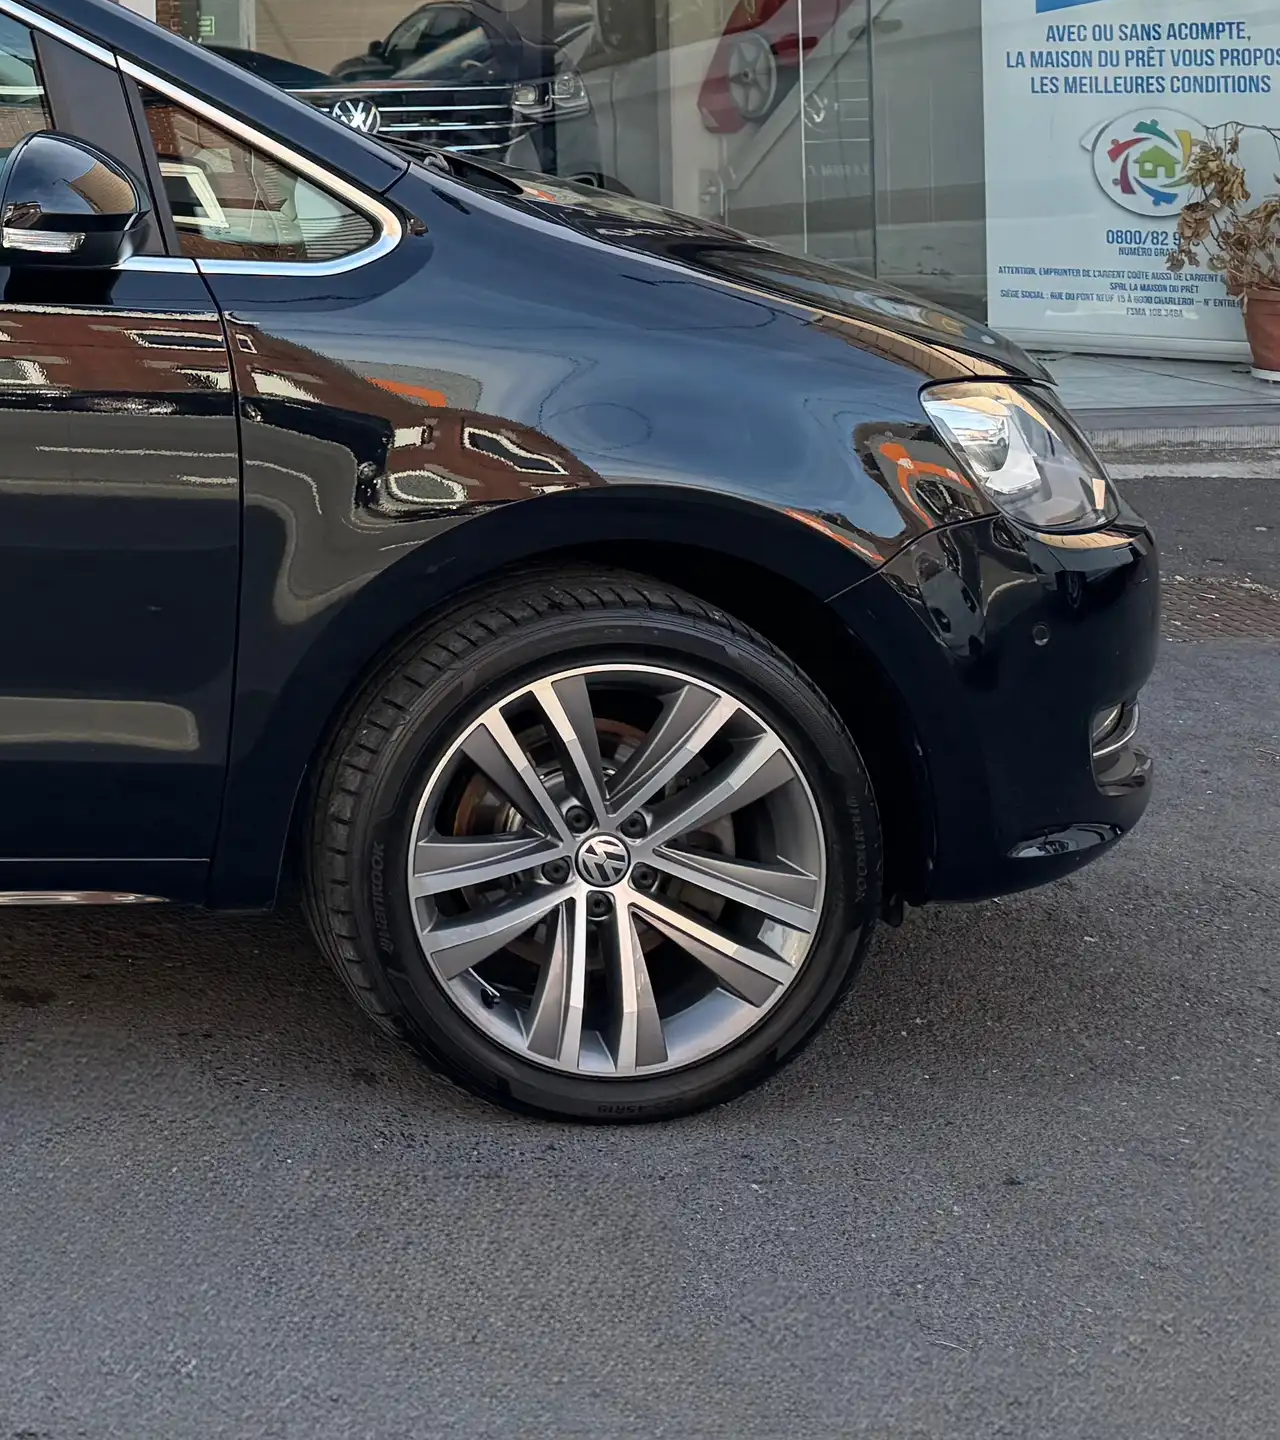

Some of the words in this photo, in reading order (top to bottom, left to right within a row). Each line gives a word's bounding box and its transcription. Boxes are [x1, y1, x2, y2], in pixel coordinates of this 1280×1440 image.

[1046, 24, 1087, 42] AVEC
[1092, 23, 1114, 42] OU
[1119, 23, 1161, 41] SANS
[1166, 21, 1251, 42] ACOMPTE,
[1006, 51, 1026, 68] LA
[1030, 50, 1092, 68] MAISON
[1098, 50, 1120, 68] DU
[1125, 46, 1164, 67] PRÊT
[1170, 49, 1215, 67] VOUS
[1031, 76, 1059, 94] LES
[1063, 76, 1165, 94] MEILLEURES
[1170, 75, 1271, 93] CONDITIONS
[1106, 229, 1169, 247] 0800/82
[1118, 246, 1152, 257] NUMÉRO
[1039, 267, 1081, 277] EMPRUNTER
[1082, 269, 1092, 278] DE
[1151, 272, 1172, 281] AUSSI
[1173, 273, 1183, 281] DE
[1109, 282, 1128, 291] SPRL
[1129, 283, 1139, 291] LA
[1140, 283, 1167, 293] MAISON
[1168, 285, 1179, 293] DU
[1021, 290, 1045, 299] SOCIAL
[1050, 292, 1064, 300] RUE
[1065, 292, 1075, 300] DU
[1153, 296, 1195, 306] CHARLEROI
